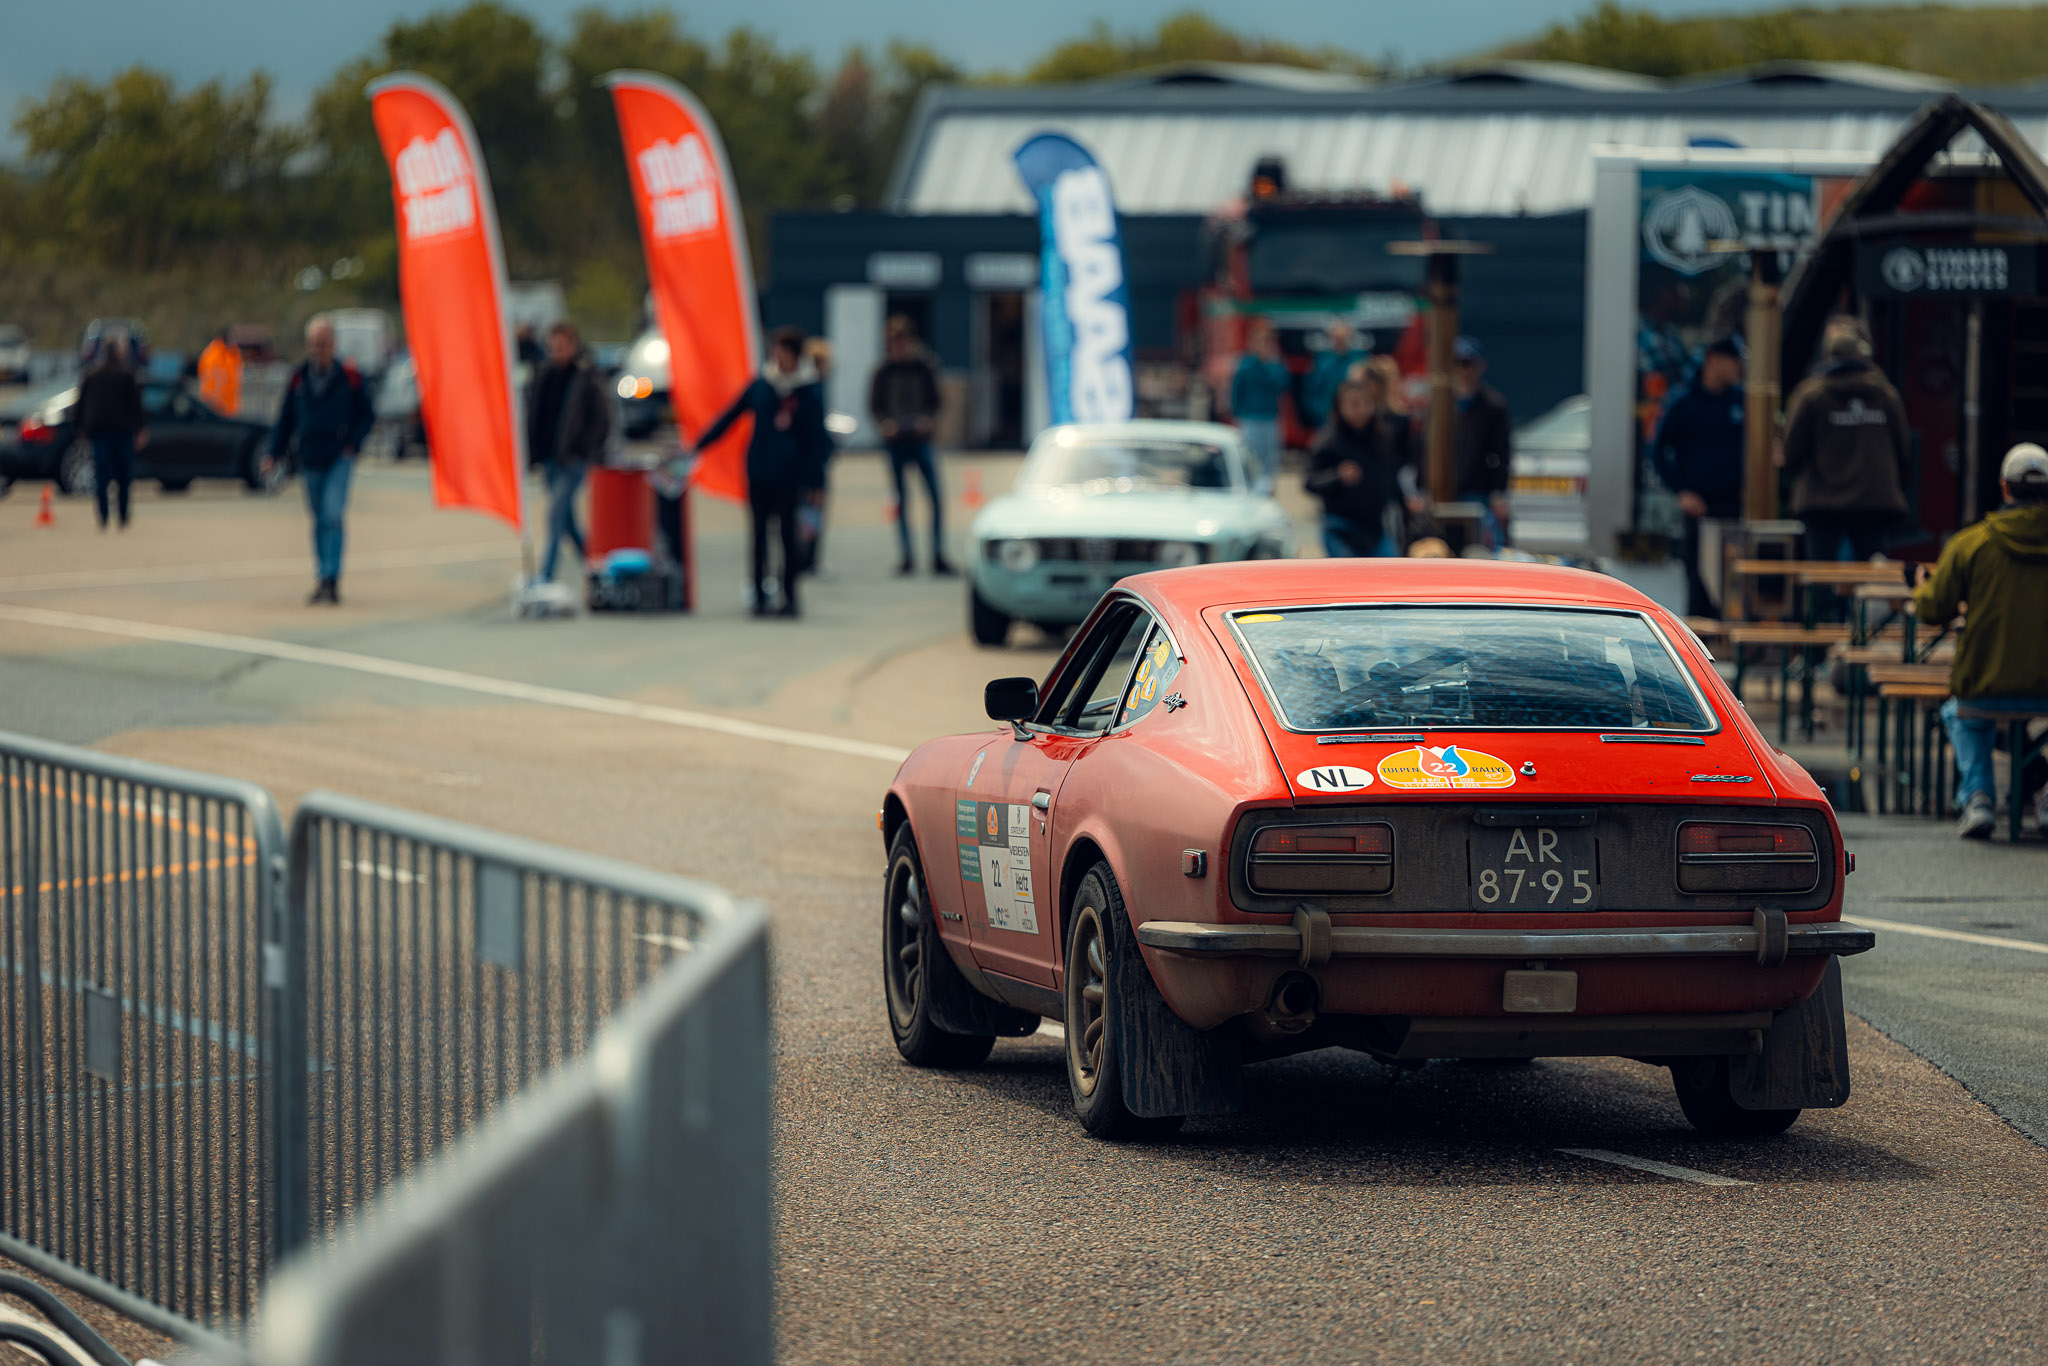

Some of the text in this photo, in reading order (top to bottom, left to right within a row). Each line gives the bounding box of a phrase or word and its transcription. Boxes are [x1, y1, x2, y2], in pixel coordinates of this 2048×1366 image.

[1311, 769, 1364, 788] NL
[1430, 762, 1459, 773] 22
[1504, 828, 1562, 863] AR
[991, 860, 1002, 887] 22
[1478, 869, 1592, 904] 87-95
